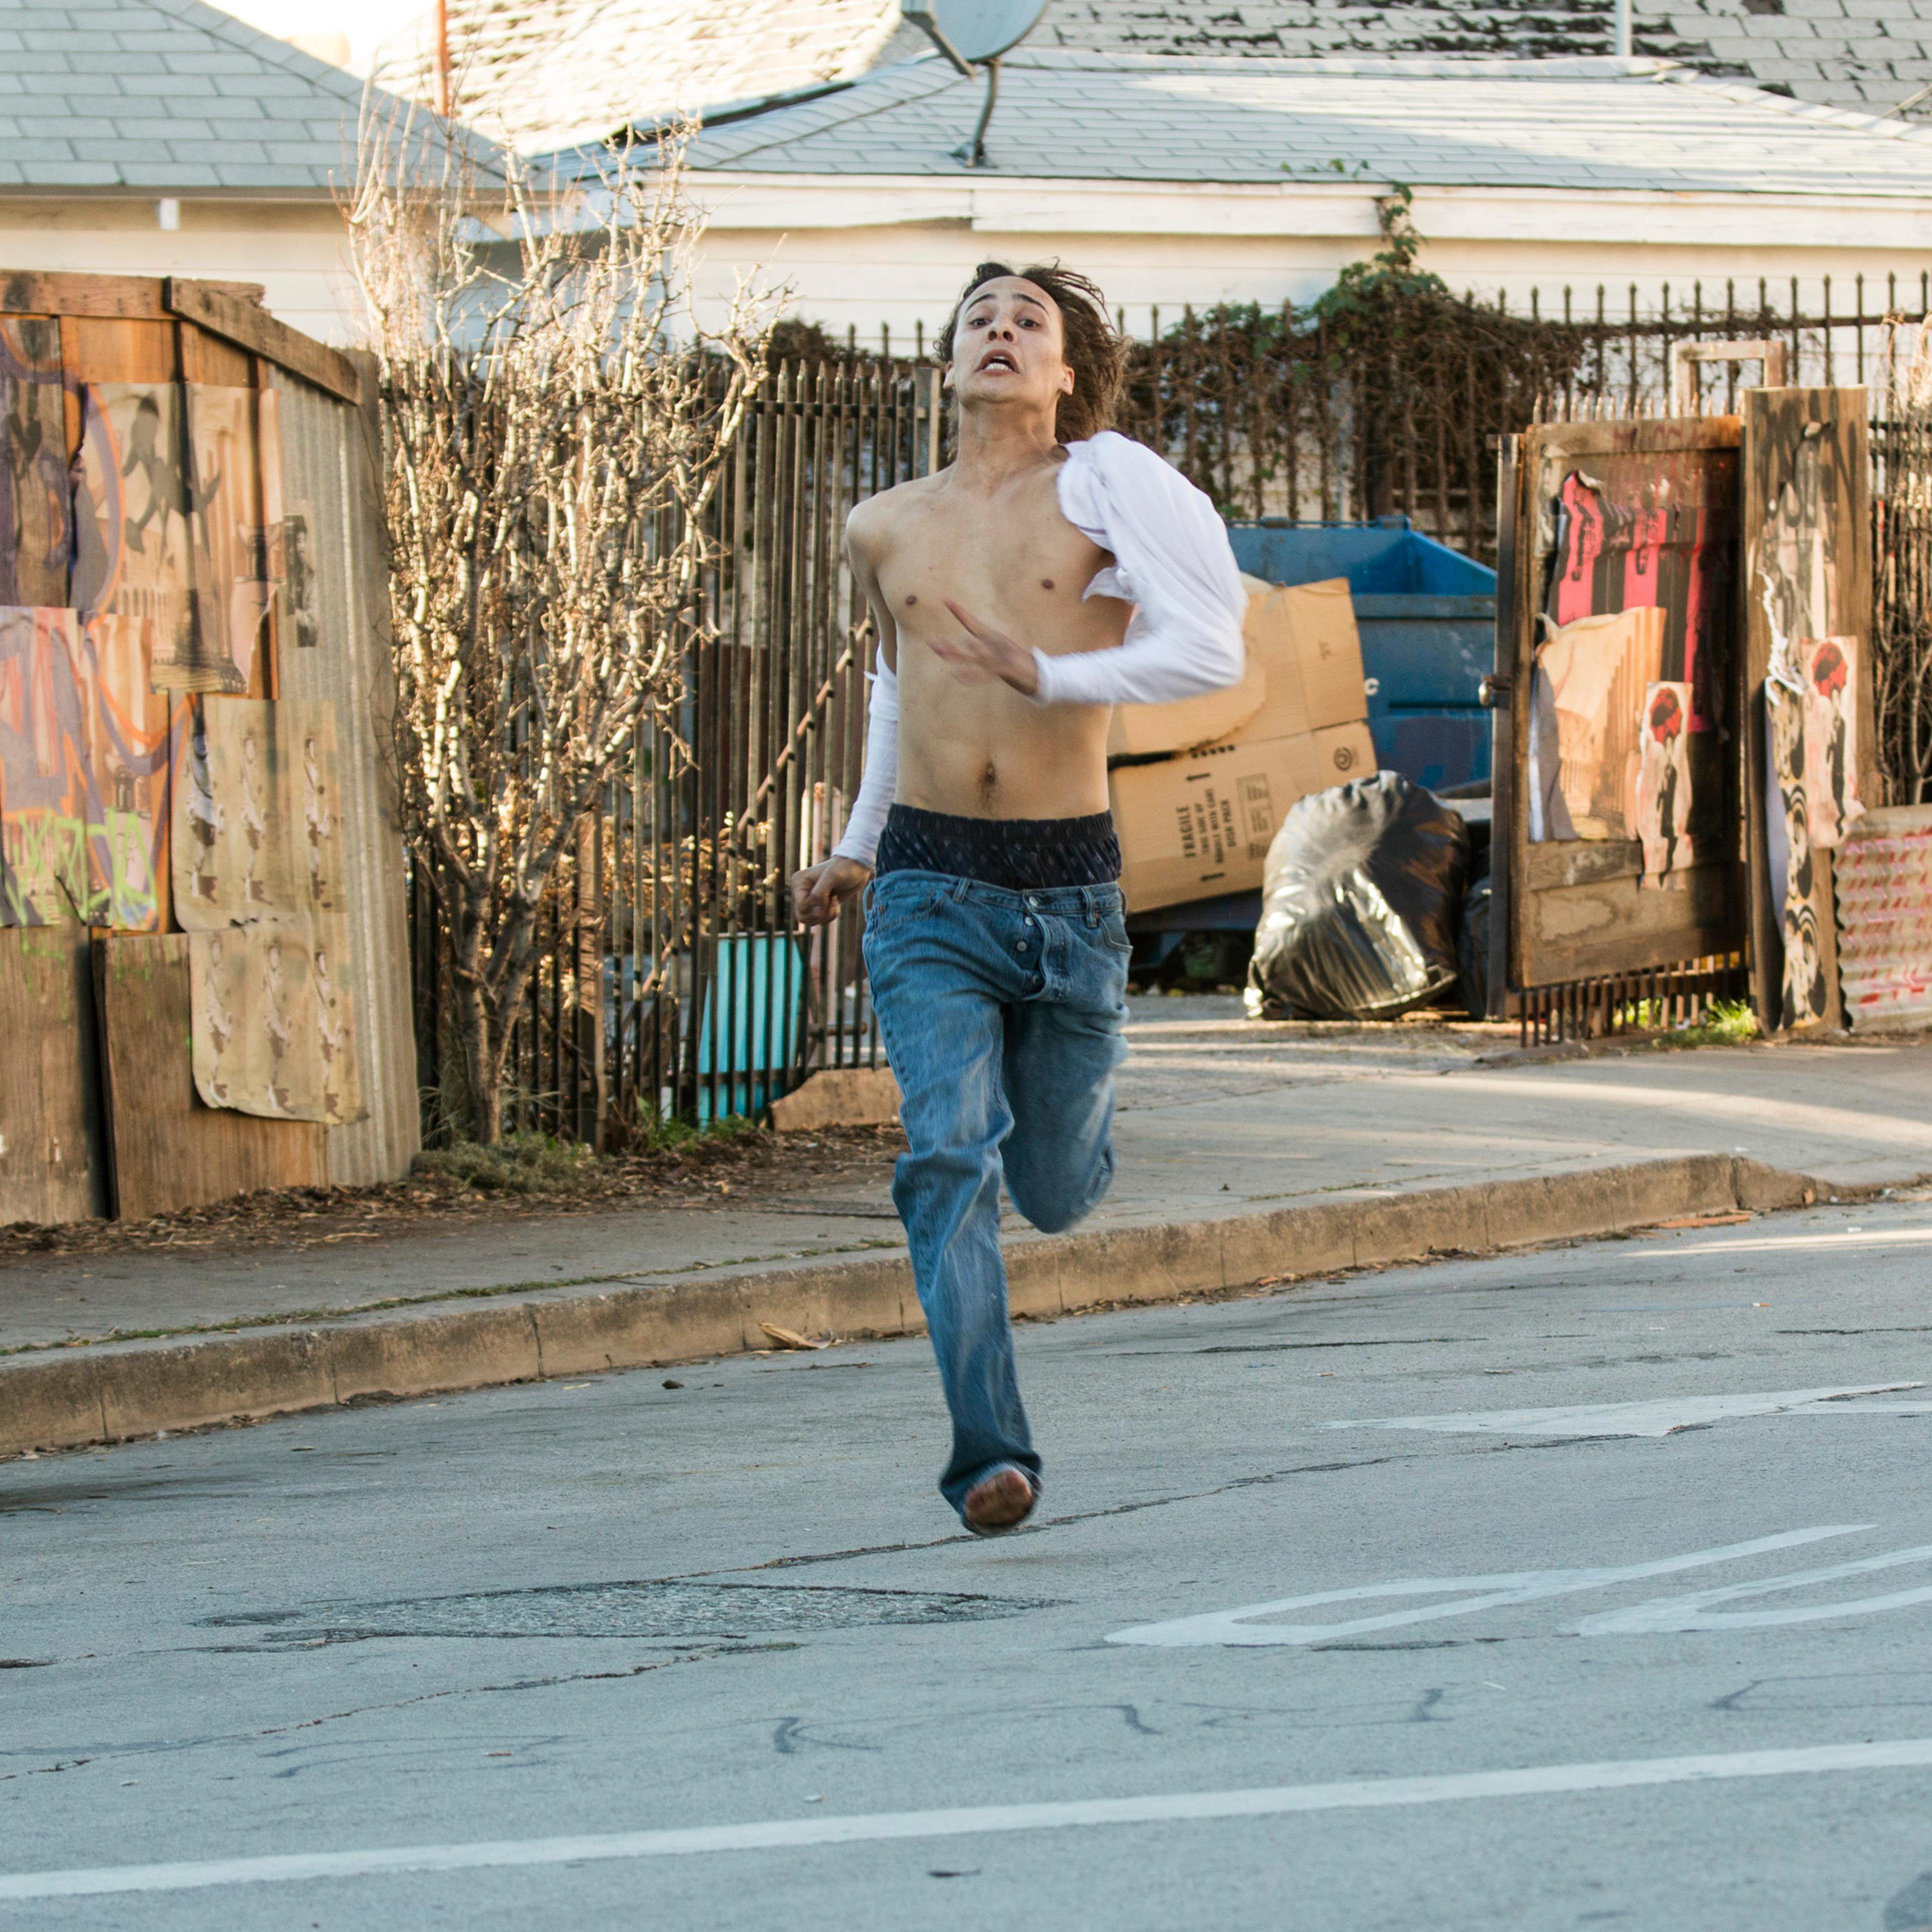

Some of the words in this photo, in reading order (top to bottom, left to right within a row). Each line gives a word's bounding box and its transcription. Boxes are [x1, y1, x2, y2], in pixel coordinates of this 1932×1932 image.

[1205, 788, 1215, 808] CARE
[1209, 812, 1219, 830] WITH
[1221, 799, 1232, 823] PACK
[1176, 807, 1196, 858] FRAGILE
